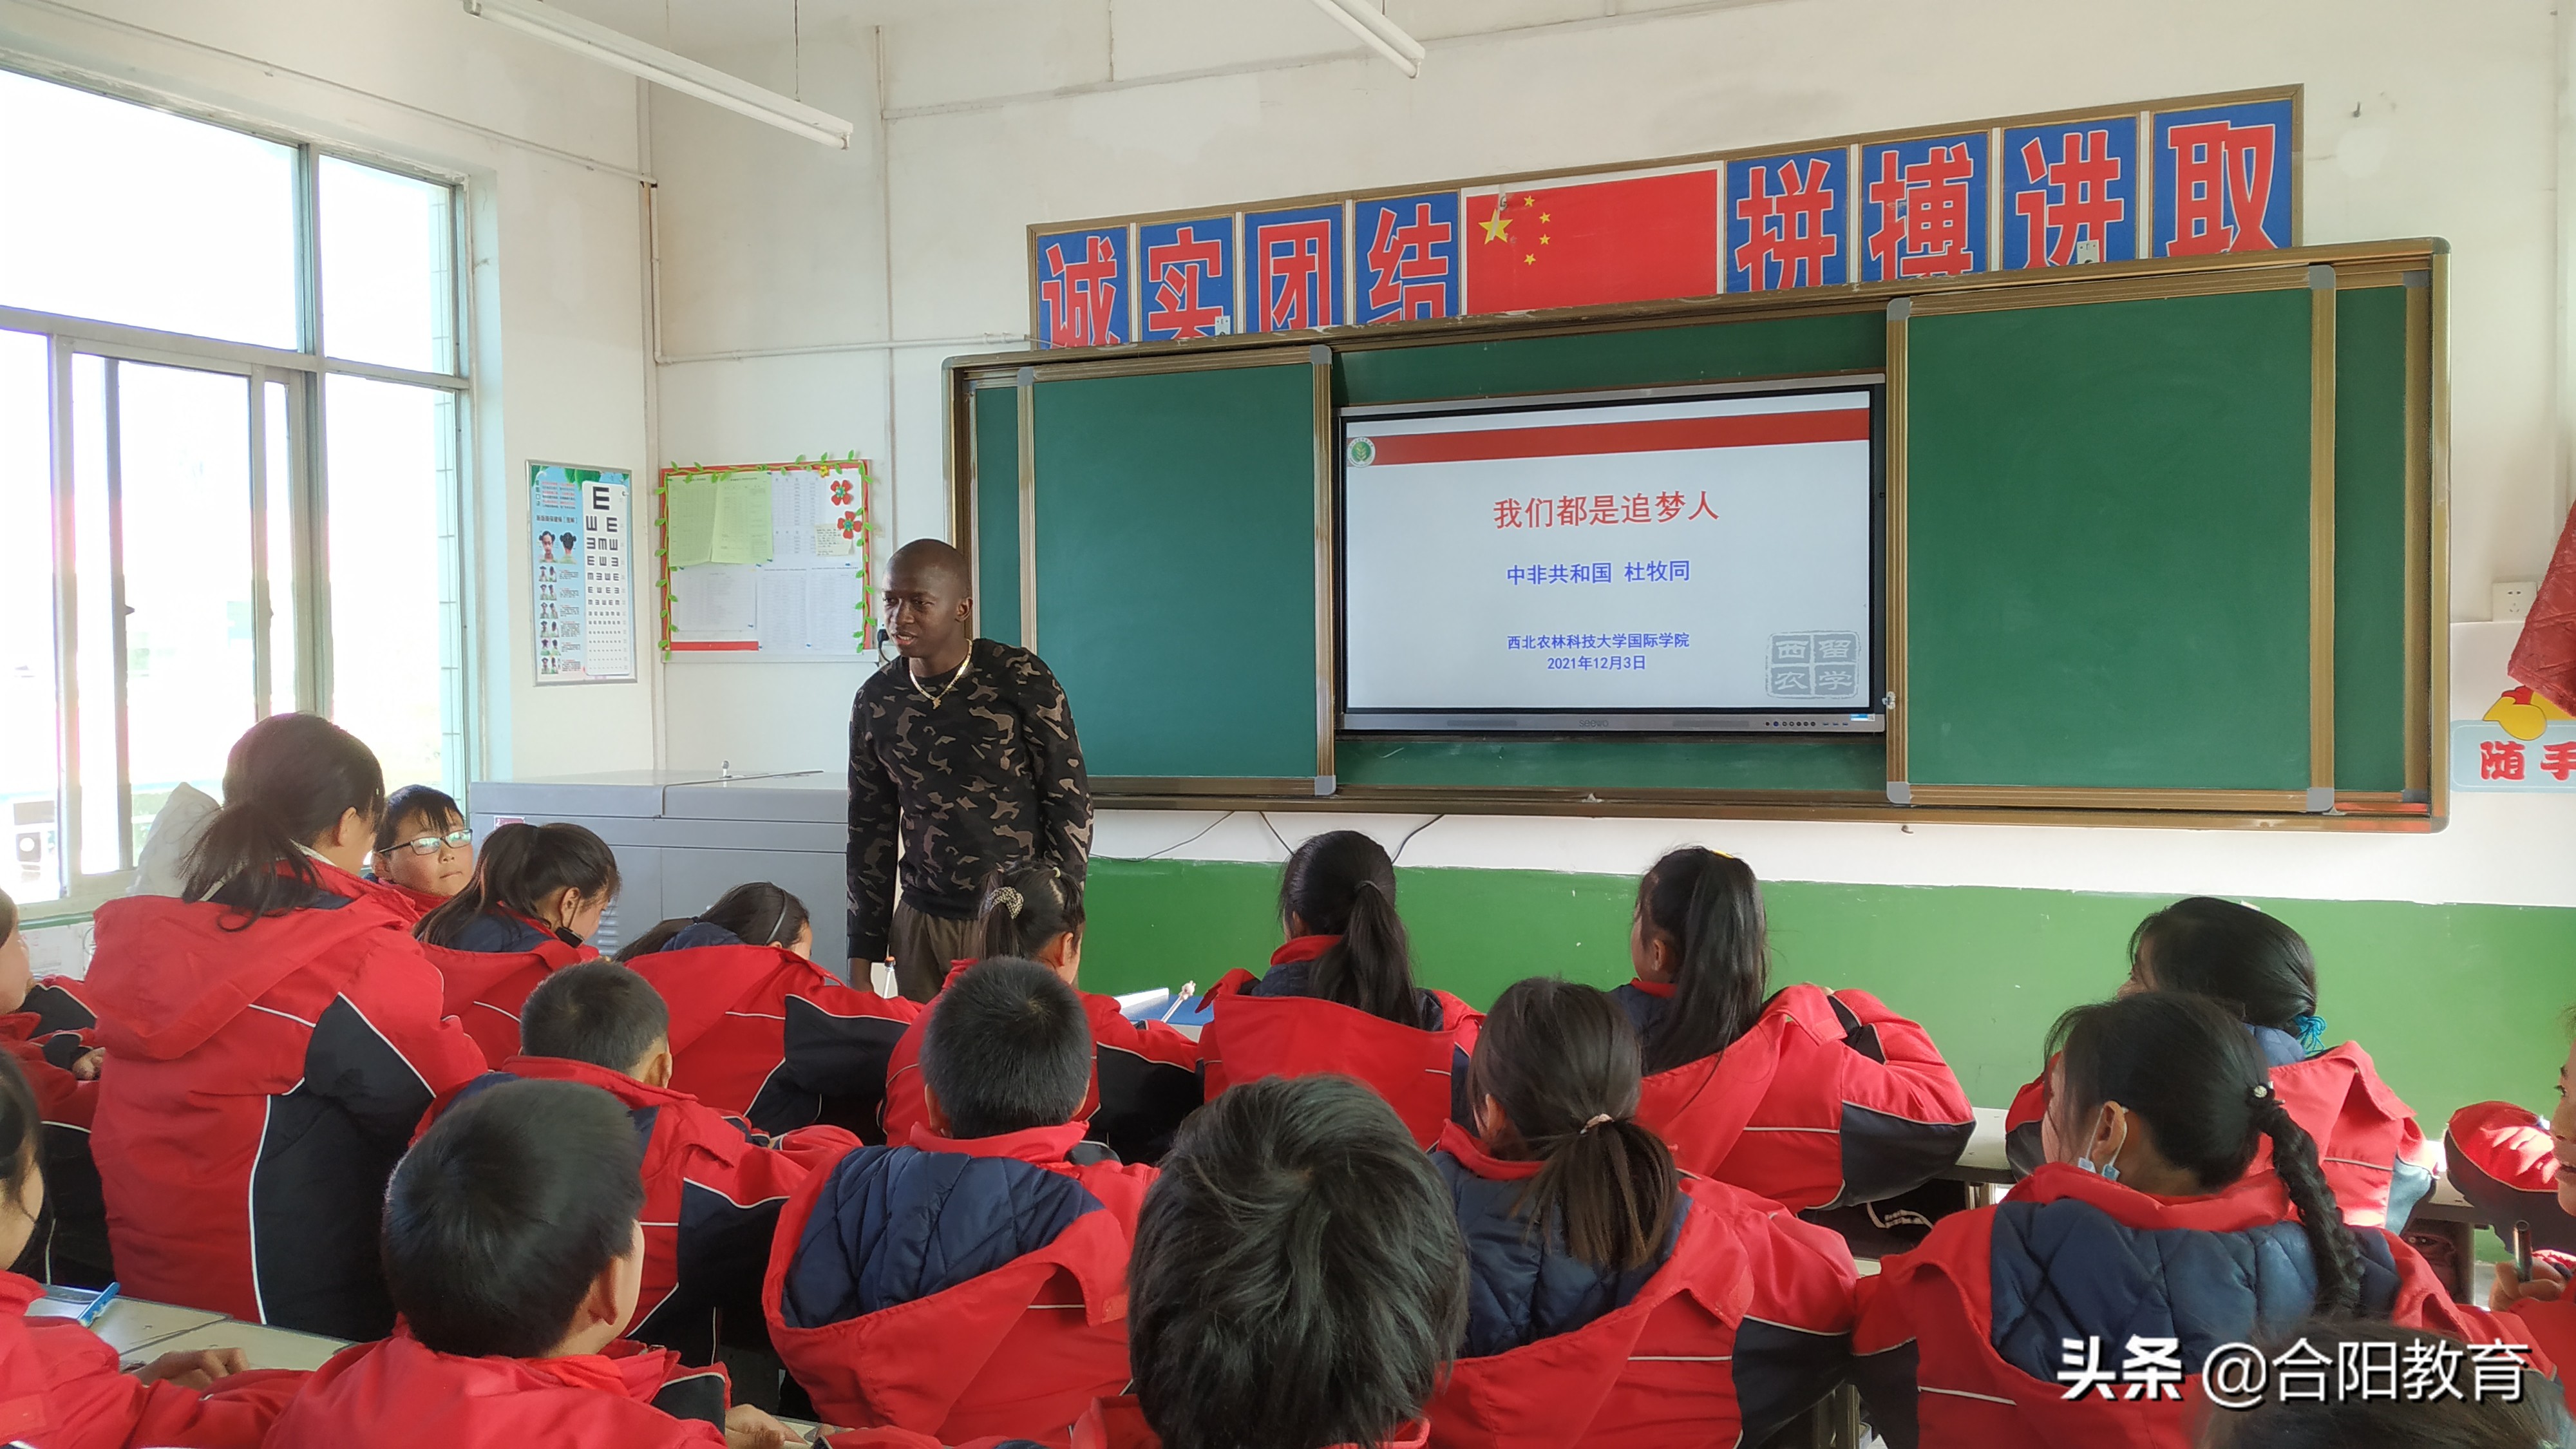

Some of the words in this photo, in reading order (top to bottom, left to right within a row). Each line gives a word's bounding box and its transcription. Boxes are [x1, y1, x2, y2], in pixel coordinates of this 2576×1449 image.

[1041, 203, 1452, 350] 诚实团结
[1734, 120, 2277, 292] 拼搏进取
[1493, 490, 1719, 529] 我们都是追梦人
[1506, 563, 1613, 586] 中非共和国
[1624, 560, 1691, 583] 杜牧同
[1507, 632, 1690, 651] 西北农林科技大学国际学院
[1546, 655, 1647, 672] 2021年12月3日
[2480, 741, 2576, 781] 随手
